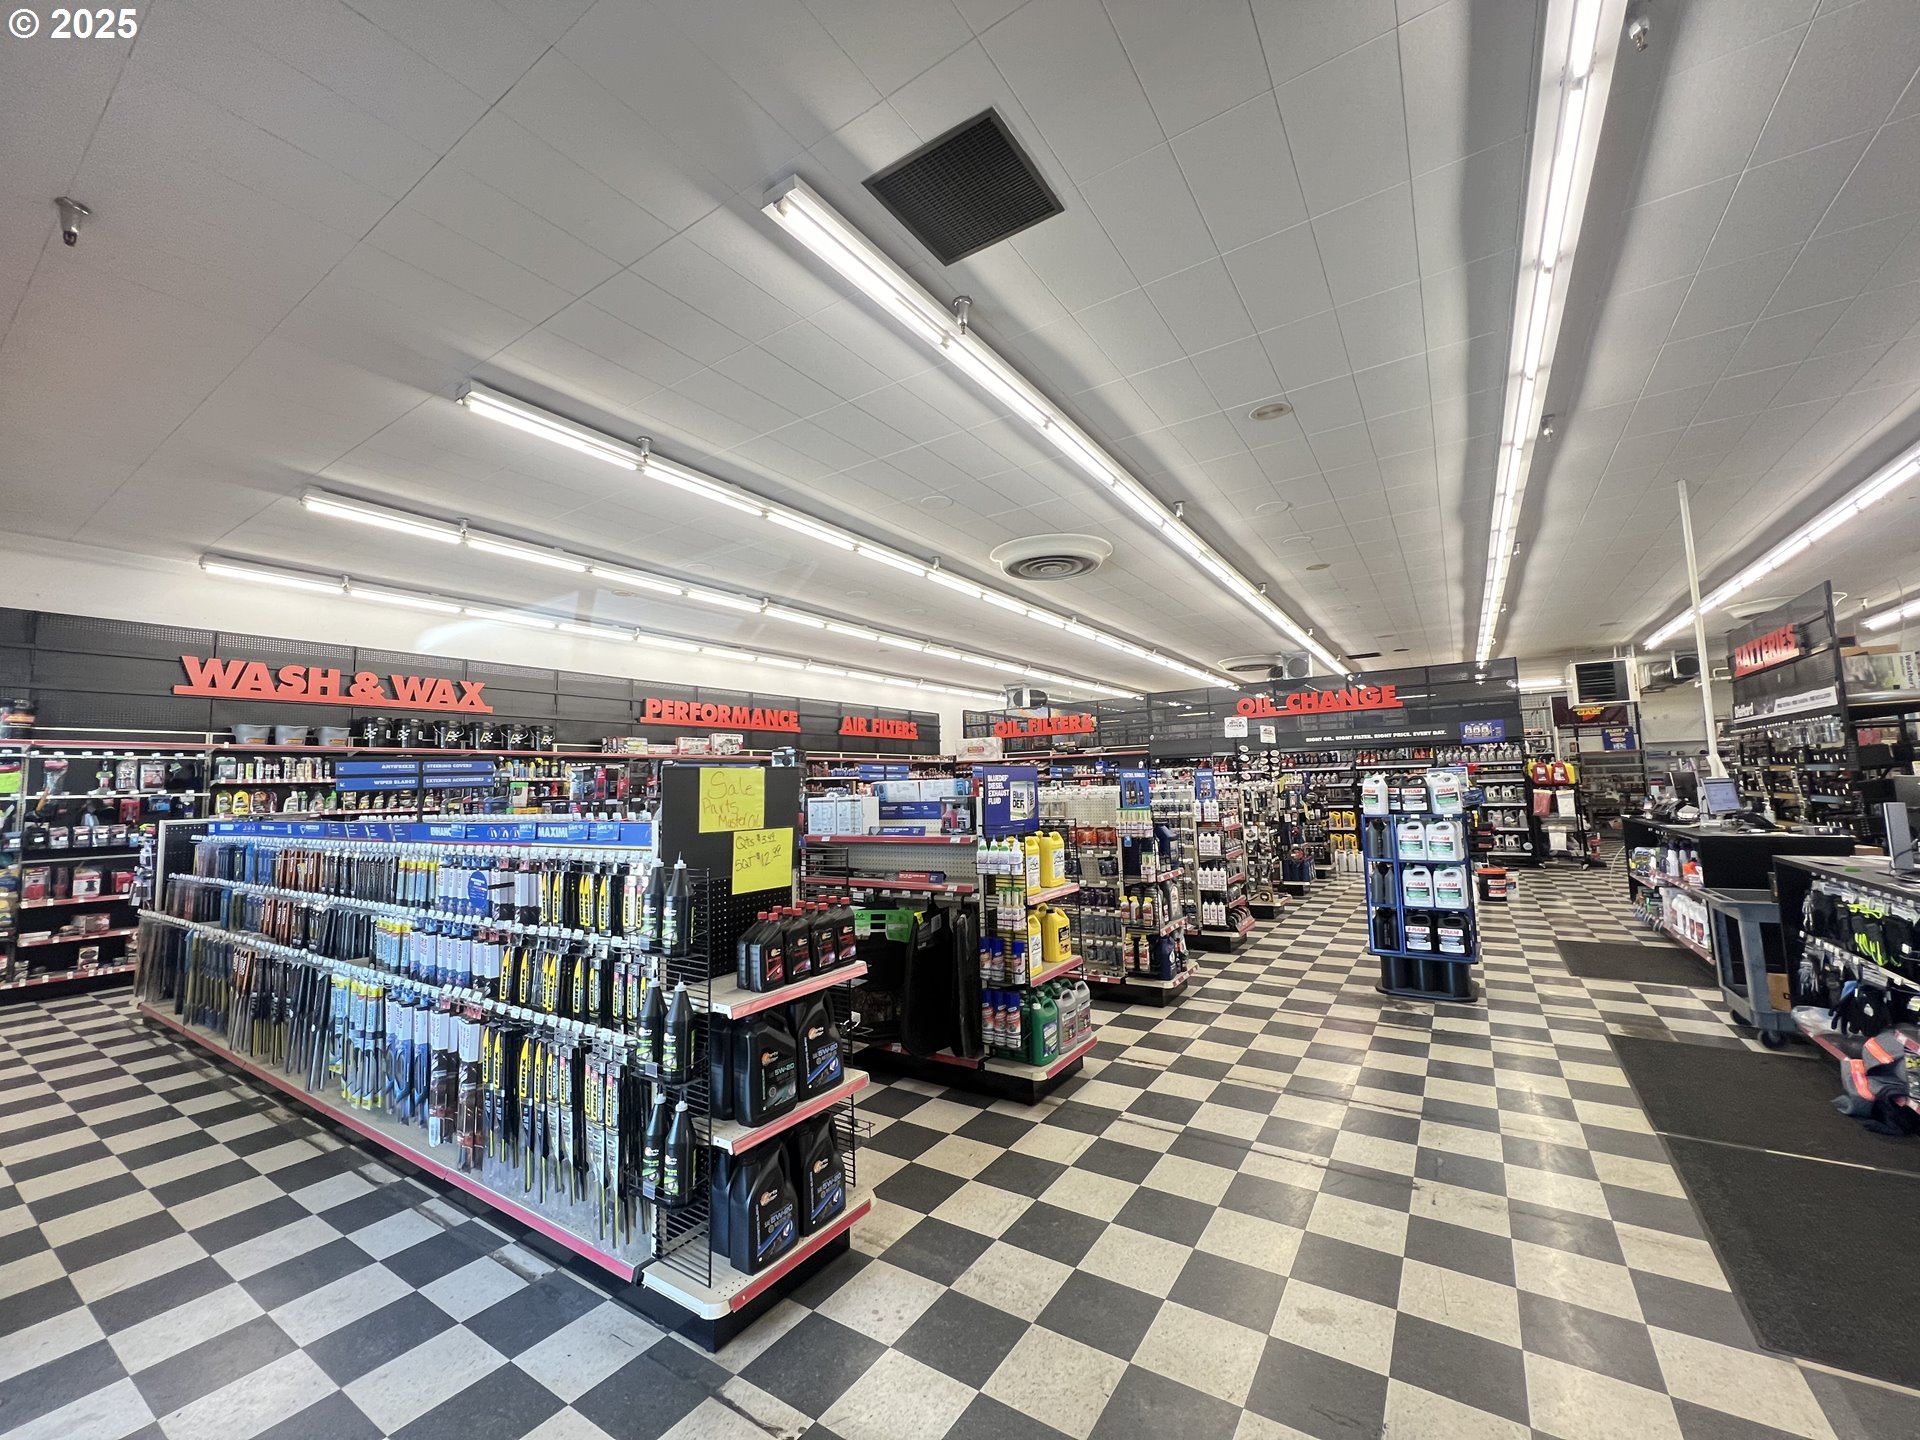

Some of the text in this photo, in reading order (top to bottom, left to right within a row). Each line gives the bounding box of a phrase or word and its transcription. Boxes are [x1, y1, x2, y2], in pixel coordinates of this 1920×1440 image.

[1734, 623, 1797, 670] BATTERIES
[180, 655, 487, 708] WASH & WAX
[645, 698, 800, 728] PERFORMANCE
[1236, 684, 1397, 715] OIL CHANGE
[841, 715, 918, 737] AIR FILTERS
[993, 713, 1093, 736] OIL FILTERS
[707, 770, 756, 800] Sale
[702, 797, 739, 816] Parts
